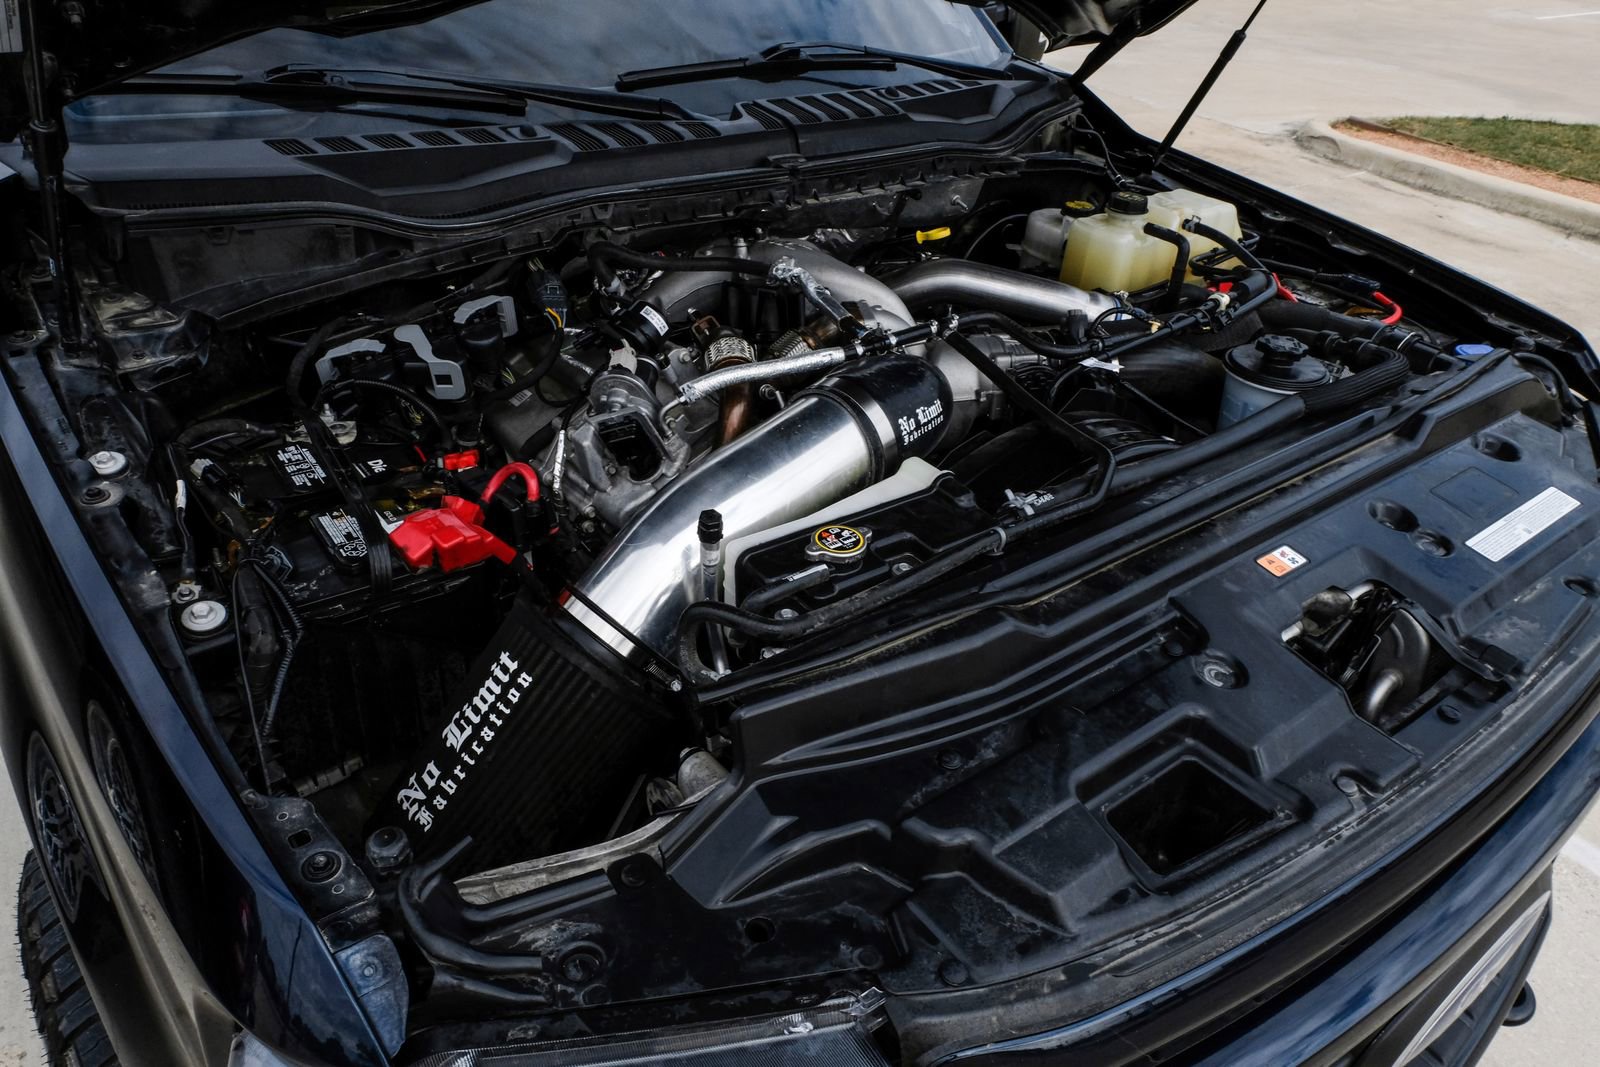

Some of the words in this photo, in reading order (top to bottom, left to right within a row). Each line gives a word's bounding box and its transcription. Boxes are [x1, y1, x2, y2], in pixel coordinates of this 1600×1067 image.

[898, 416, 916, 436] No
[916, 399, 942, 425] Limit
[903, 415, 944, 445] Fabrication
[397, 760, 441, 821] No
[442, 651, 518, 752] Limit
[415, 672, 532, 832] Fabrication
